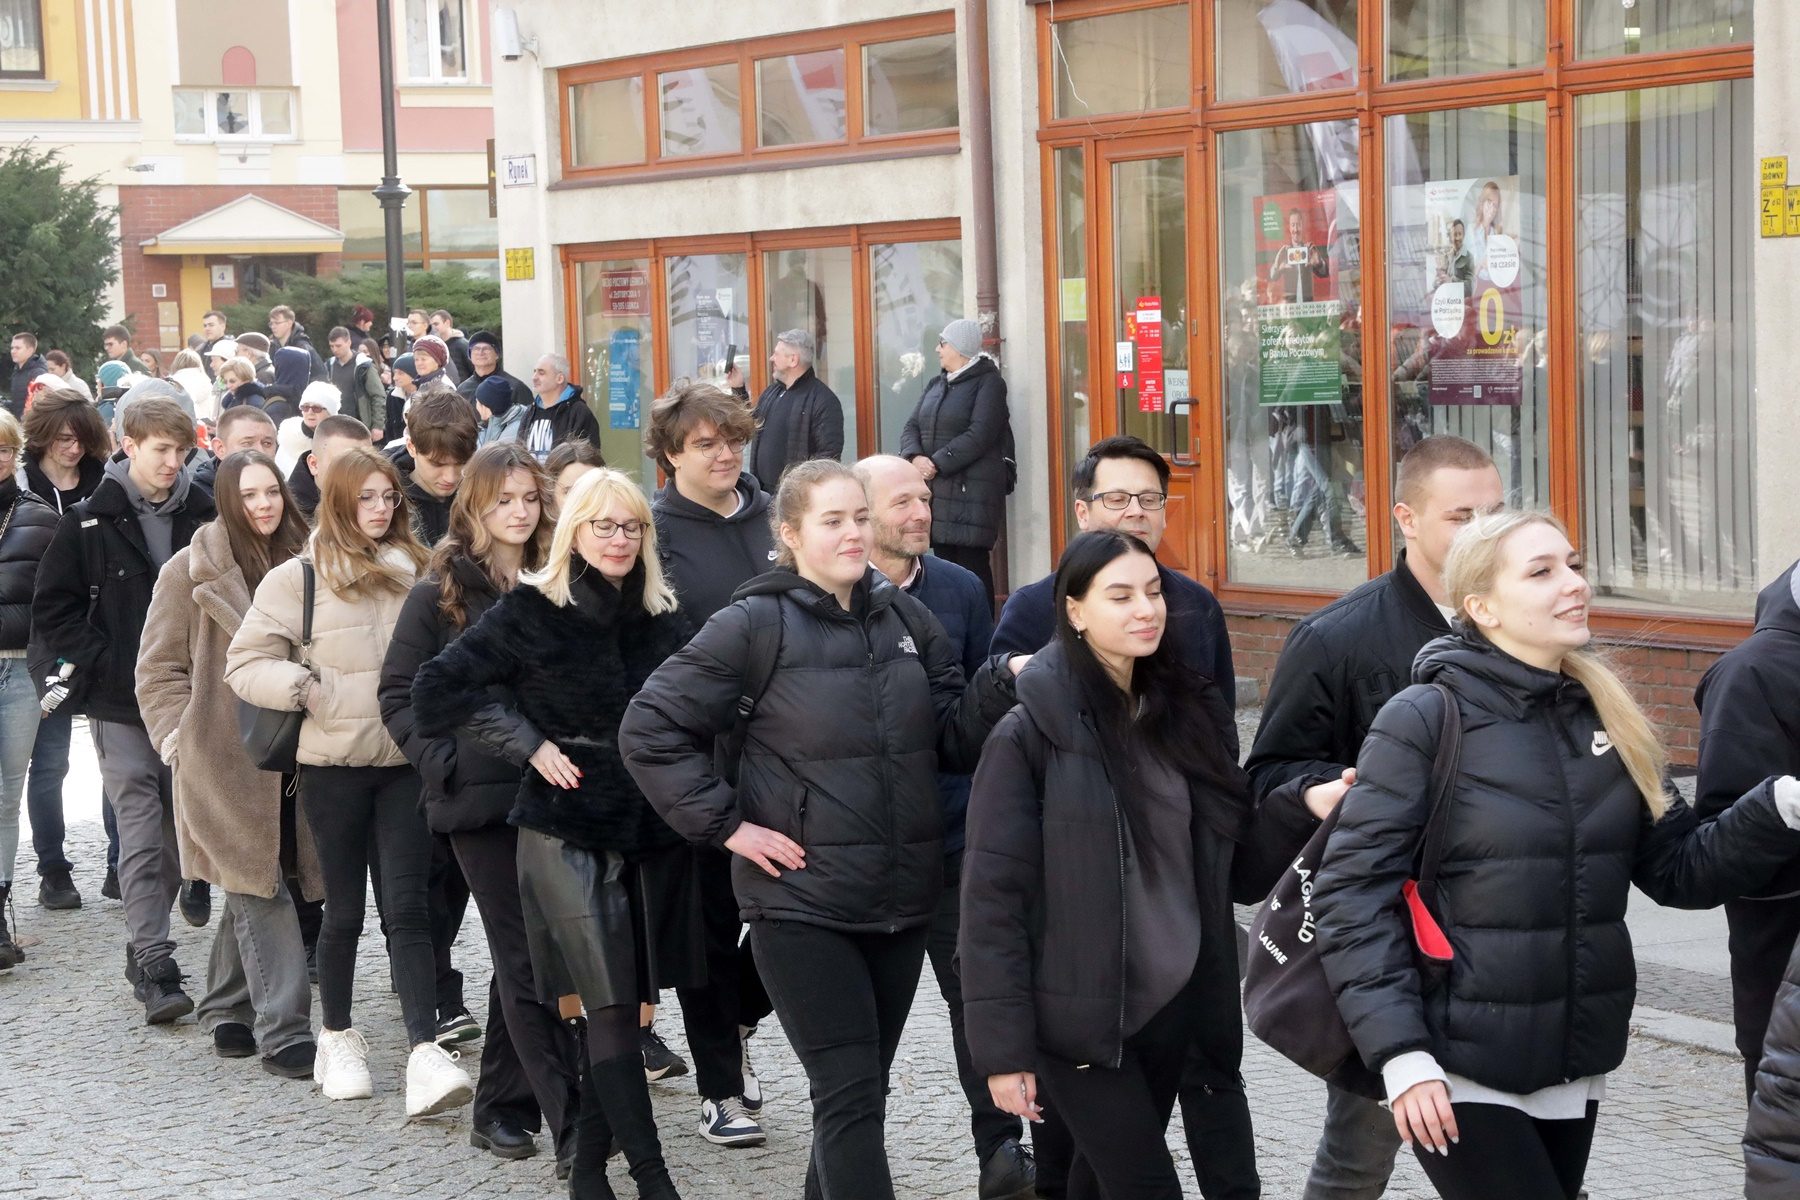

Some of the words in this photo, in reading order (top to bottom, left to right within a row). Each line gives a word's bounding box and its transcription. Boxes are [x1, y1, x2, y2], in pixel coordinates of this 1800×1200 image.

[508, 160, 528, 183] Rynek
[1480, 288, 1504, 346] 0
[1258, 930, 1288, 965] LAUME
